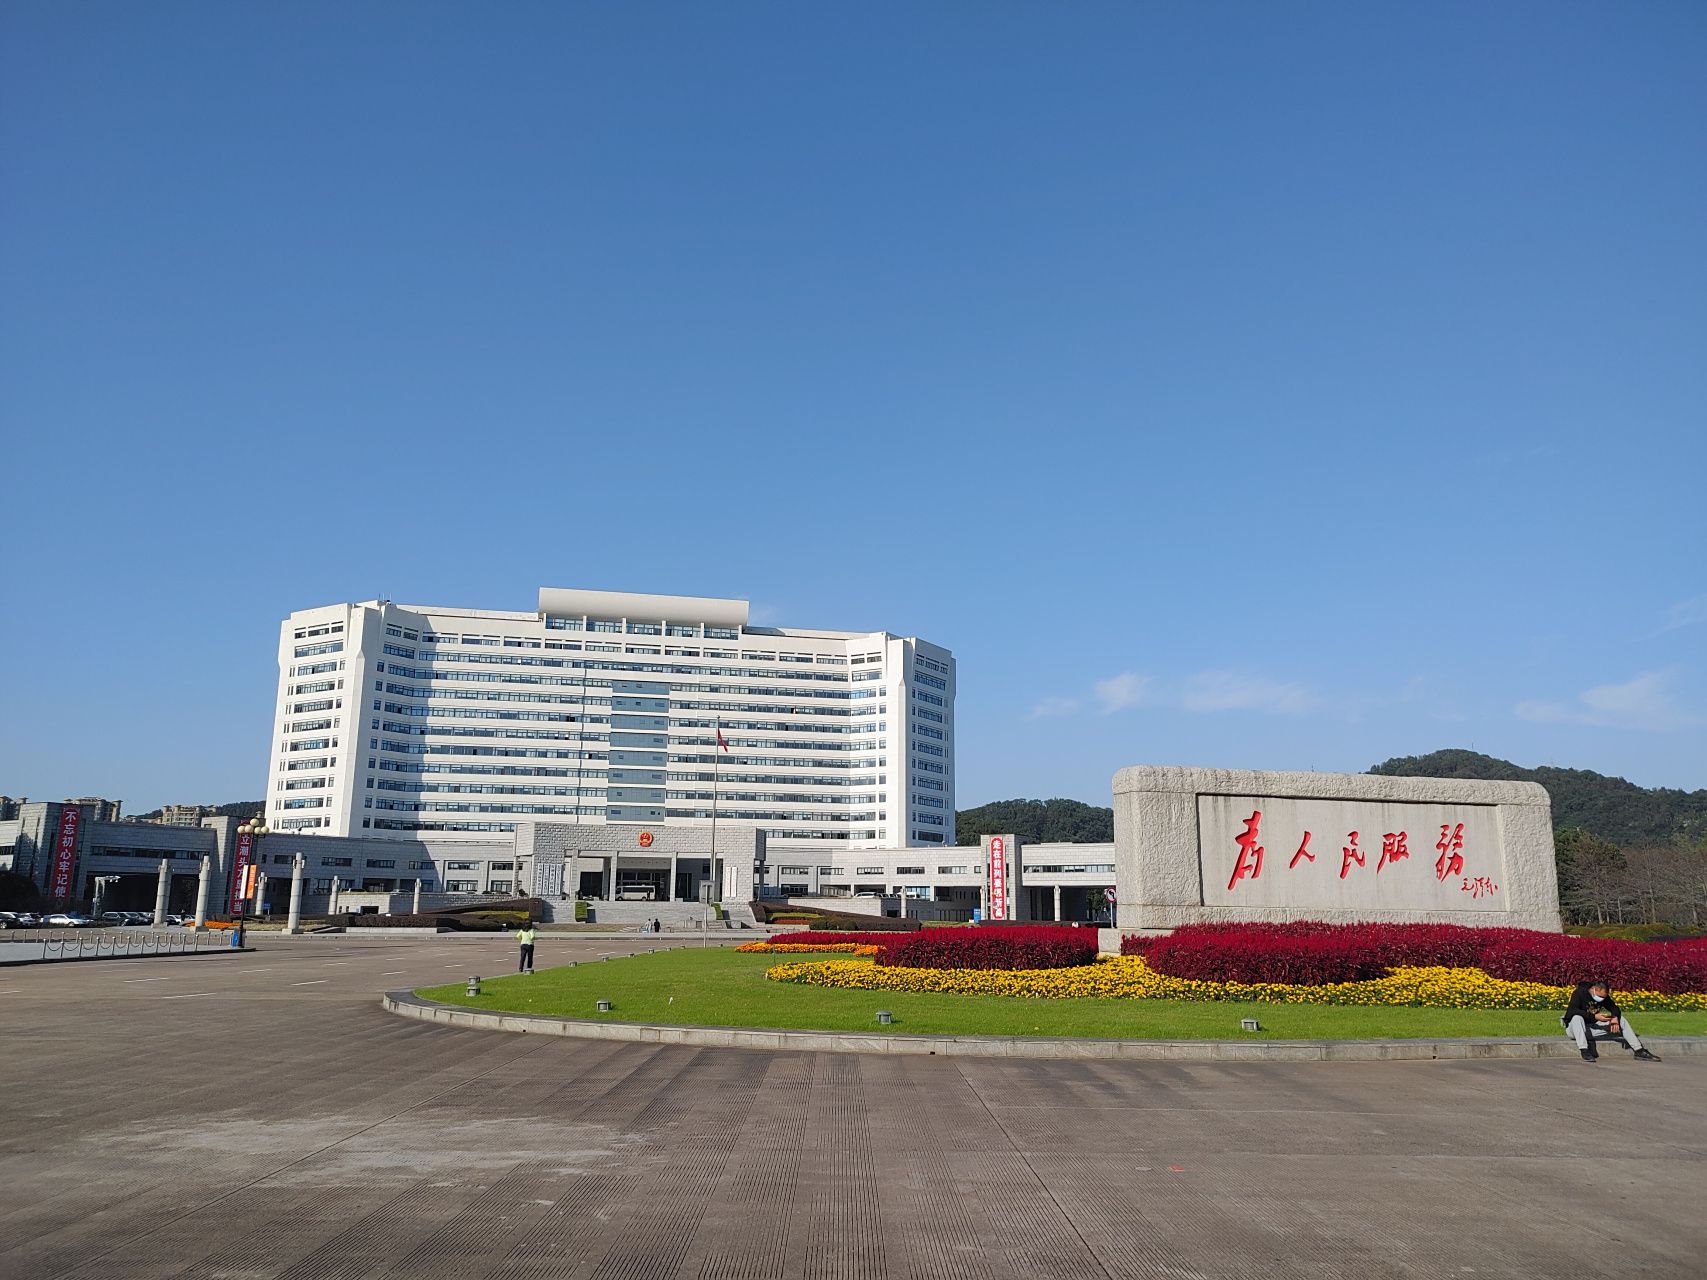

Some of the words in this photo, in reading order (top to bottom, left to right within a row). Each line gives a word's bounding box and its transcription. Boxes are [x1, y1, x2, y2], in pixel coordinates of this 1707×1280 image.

[54, 811, 77, 907] 不忘初心牢记使
[233, 822, 252, 912] 立潮头方显担当
